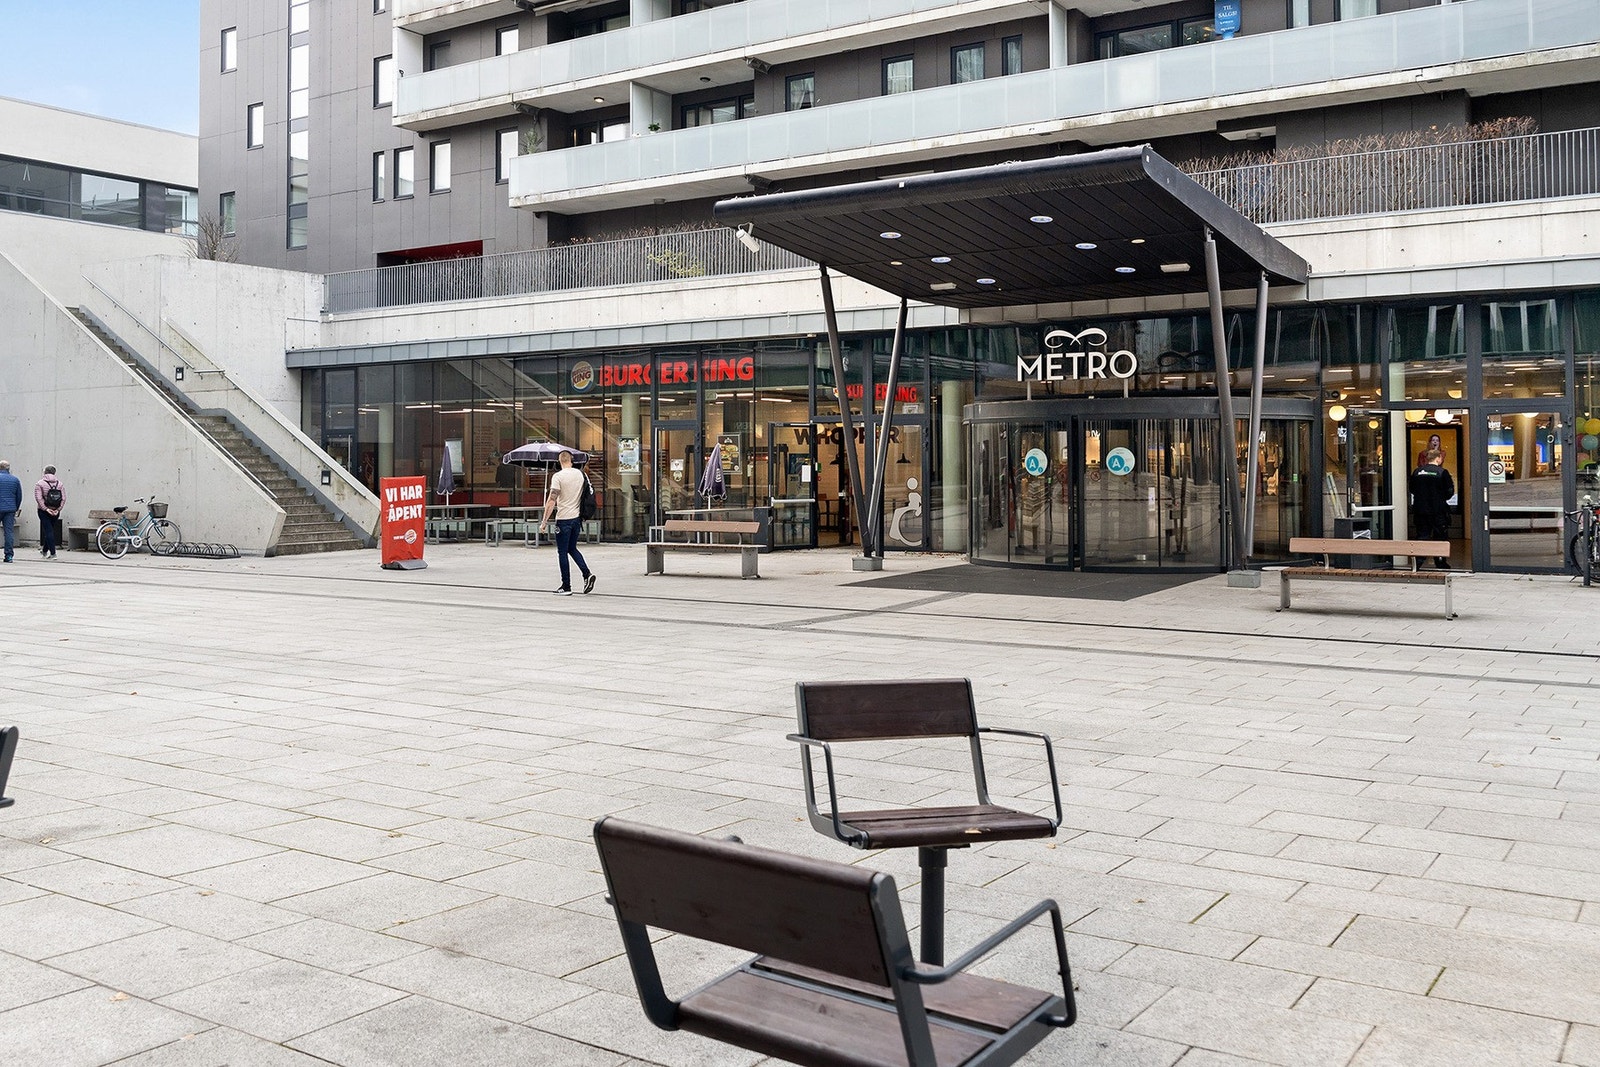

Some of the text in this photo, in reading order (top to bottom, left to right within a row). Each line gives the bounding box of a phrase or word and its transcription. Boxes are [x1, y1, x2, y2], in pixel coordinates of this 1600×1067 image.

[1017, 350, 1138, 382] METRO
[572, 371, 592, 384] KING
[1112, 457, 1121, 468] A
[386, 485, 422, 502] VI HAR
[388, 504, 422, 522] ÅPENT
